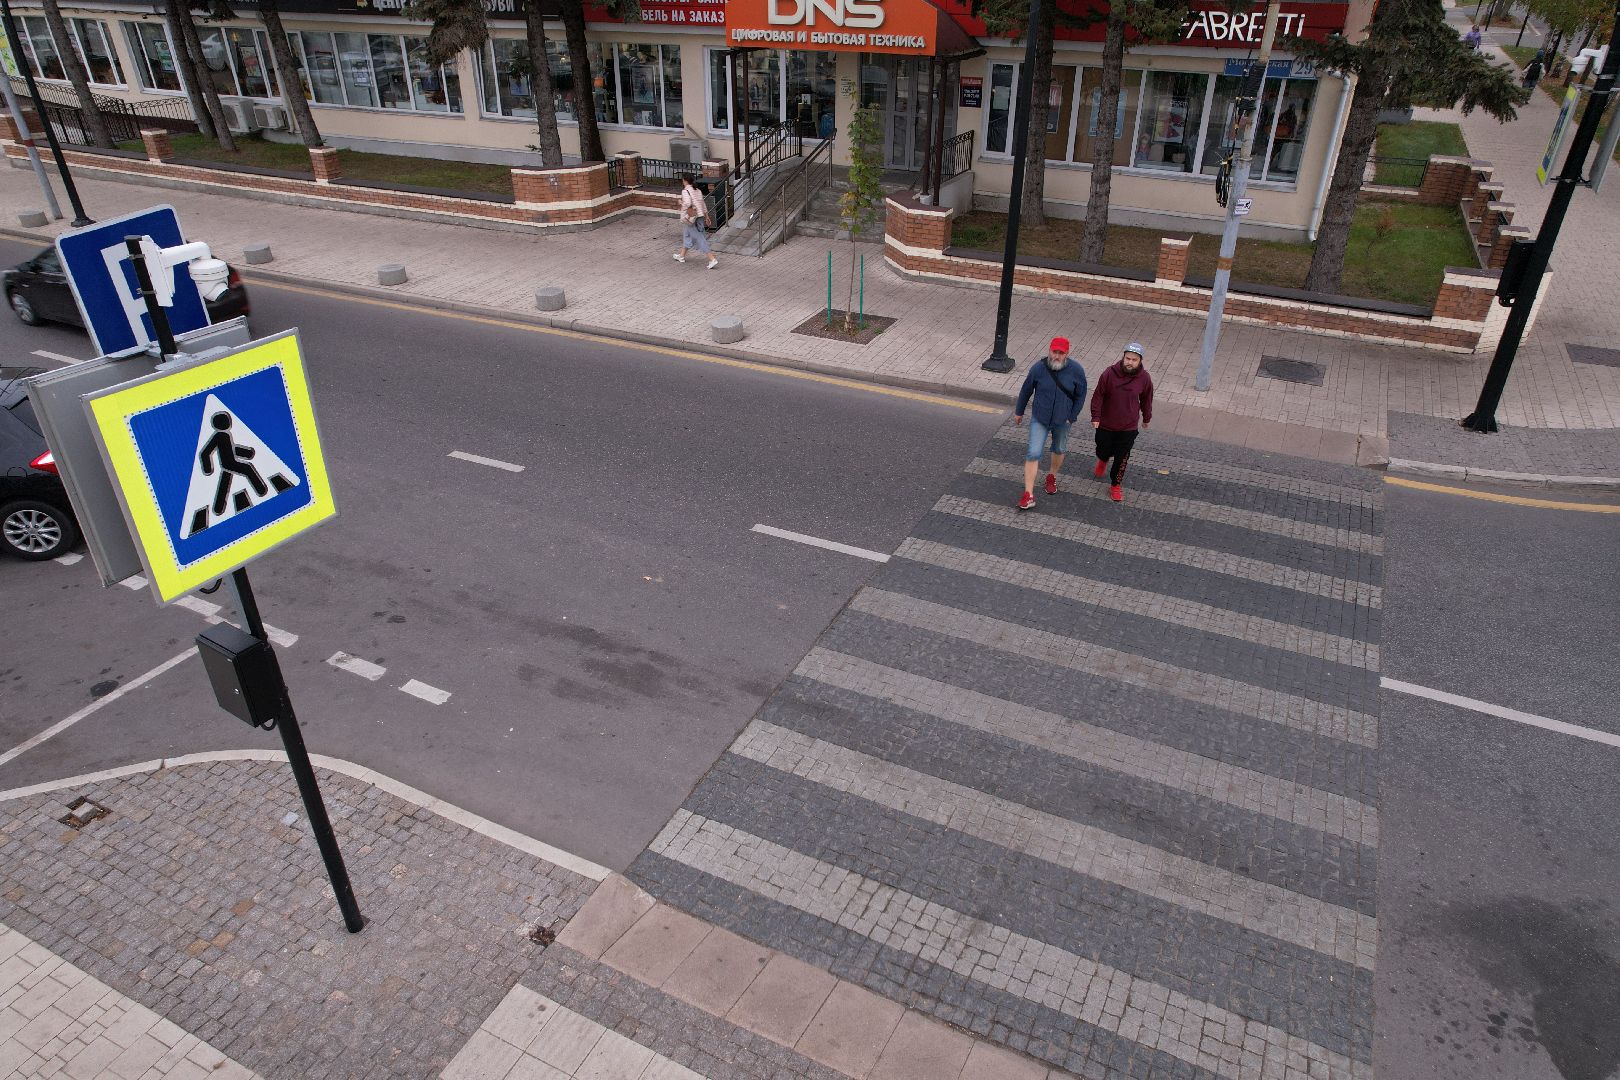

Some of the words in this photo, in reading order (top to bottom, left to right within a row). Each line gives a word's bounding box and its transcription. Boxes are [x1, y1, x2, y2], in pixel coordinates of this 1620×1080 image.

[671, 10, 686, 22] НА
[689, 10, 725, 23] ЗАКАЗ
[768, 0, 886, 28] DNS
[731, 29, 795, 42] ЦИФРОВАЯ
[797, 31, 807, 42] И
[810, 32, 866, 45] БЫТОВАЯ
[869, 34, 926, 48] ТЕХНИКА
[1294, 60, 1313, 76] 29
